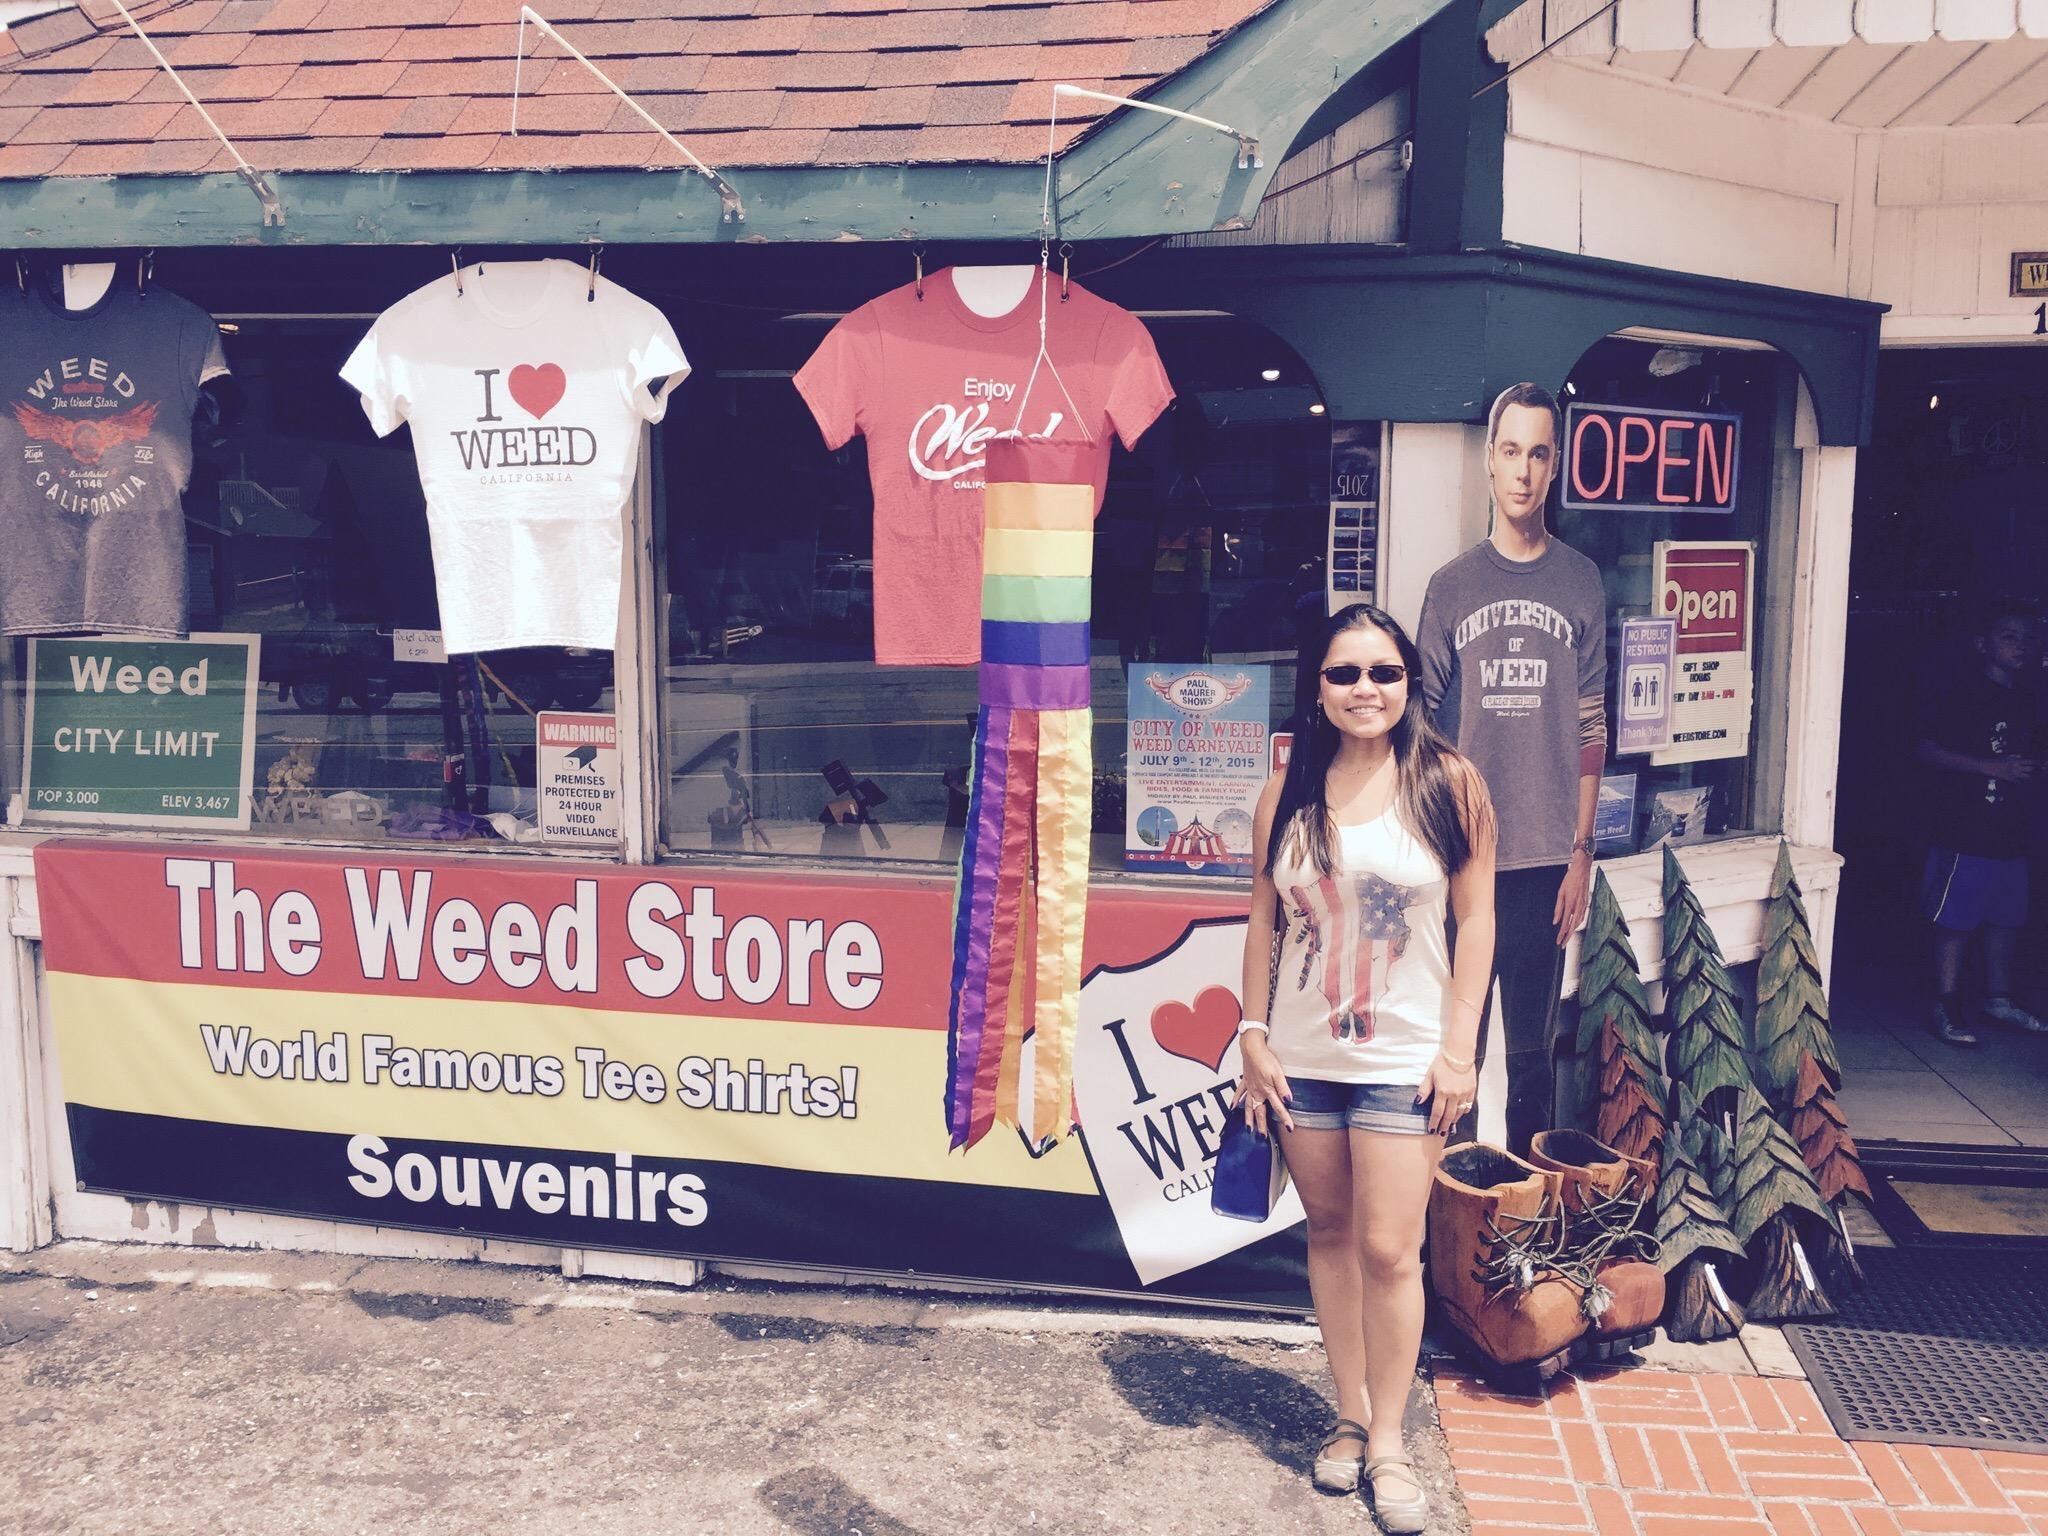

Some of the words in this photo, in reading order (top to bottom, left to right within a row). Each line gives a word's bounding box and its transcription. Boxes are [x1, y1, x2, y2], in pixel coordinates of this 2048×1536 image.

[27, 357, 136, 400] WEED
[474, 368, 503, 422] I
[963, 377, 1017, 402] Enjoy
[52, 397, 67, 410] The
[70, 397, 92, 408] Weed
[94, 397, 118, 409] Store
[450, 426, 597, 470] WEED
[908, 402, 1063, 480] Wed
[1571, 413, 1733, 504] OPEN
[479, 472, 574, 486] CALIFORNIA
[1336, 474, 1369, 496] 2015
[36, 471, 147, 517] CALIFORNIA
[1664, 579, 1737, 630] Open
[1455, 598, 1574, 651] UNIVERSITY
[1628, 630, 1639, 641] NO
[1641, 628, 1668, 641] PUBLIC
[1508, 637, 1525, 652] OF
[1626, 644, 1668, 657] RESTROOM
[69, 655, 209, 696] Weed
[1479, 658, 1548, 688] WEED
[1702, 661, 1720, 671] SHOP
[1179, 688, 1216, 697] MAURER
[1187, 679, 1209, 688] PAUL
[1182, 696, 1214, 706] SHOWS
[543, 723, 616, 744] WARNING
[1132, 720, 1175, 736] CITY
[1182, 720, 1204, 737] OF
[1210, 720, 1265, 738] WEED
[1623, 727, 1648, 740] Thank
[54, 727, 124, 754] CITY
[134, 729, 220, 758] LIMIT
[1132, 738, 1173, 752] WEED
[1177, 739, 1264, 755] CARNEVALE
[1140, 755, 1169, 766] JULY
[1172, 756, 1188, 766] 9th
[1226, 757, 1255, 768] 2015
[554, 774, 605, 786] PREMISES
[37, 790, 62, 803] POP
[65, 791, 99, 805] 3,000
[161, 795, 191, 808] ELEV
[195, 796, 230, 811] 3,467
[545, 787, 601, 799] PROTECTED
[603, 789, 616, 800] BY
[558, 800, 572, 810] 24
[574, 801, 602, 812] HOUR
[566, 814, 596, 824] VIDEO
[545, 825, 618, 838] SURVEILLANCE
[165, 858, 322, 977] The
[343, 866, 599, 993] Weed
[623, 880, 884, 1011] Store
[1102, 1018, 1157, 1106] I
[200, 1024, 349, 1083] World
[362, 1034, 564, 1097] Famous
[575, 1046, 667, 1104] Tee
[676, 1055, 860, 1120] Shirts!
[1117, 1075, 1242, 1181] WEE
[345, 1133, 709, 1228] Souvenirs
[1163, 1166, 1215, 1202] CALI
